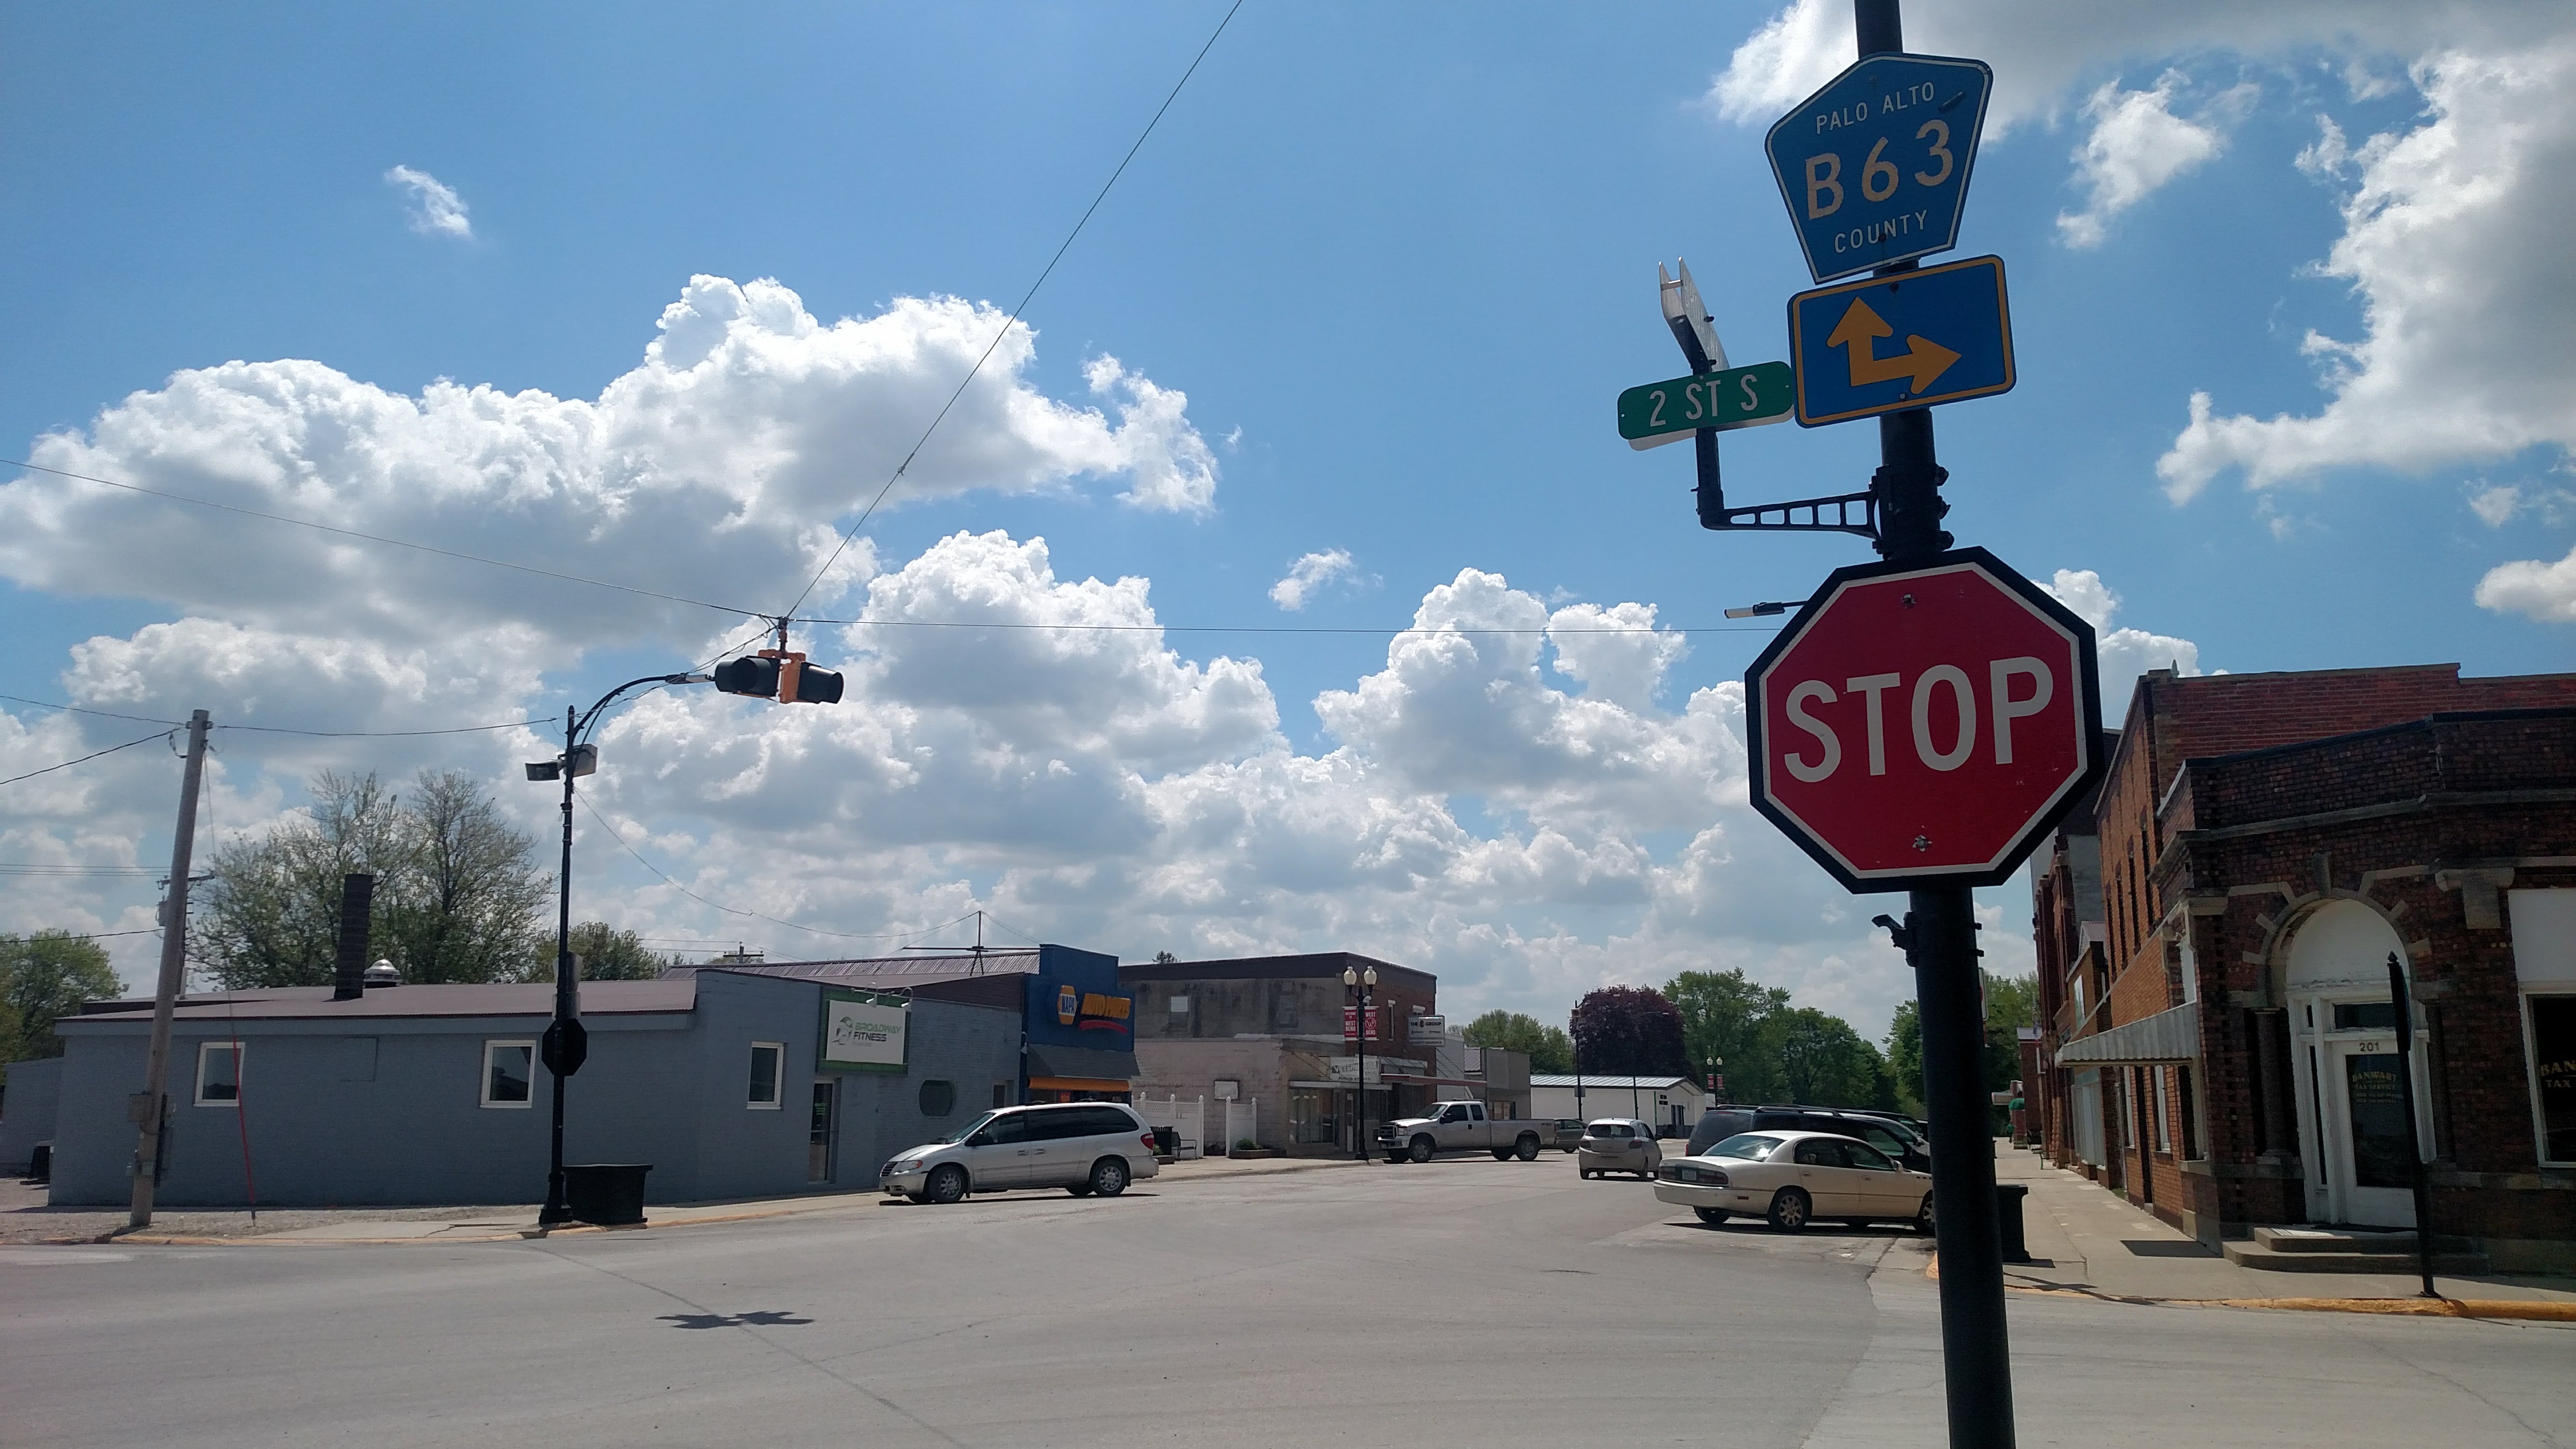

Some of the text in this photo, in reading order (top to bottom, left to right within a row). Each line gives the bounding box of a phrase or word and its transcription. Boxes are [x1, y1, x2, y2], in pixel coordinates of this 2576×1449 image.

[1817, 81, 1934, 134] PALO ALTO
[1834, 210, 1927, 254] COUNTY
[1650, 375, 1758, 428] 2 ST S
[1784, 656, 2054, 783] STOP
[1062, 996, 1074, 1015] NAPA
[1081, 993, 1105, 1016] AUTO
[853, 1031, 887, 1042] FITNESS
[855, 1022, 902, 1034] BROADWAY
[2359, 1042, 2380, 1051] 201
[2545, 1079, 2572, 1088] TAX
